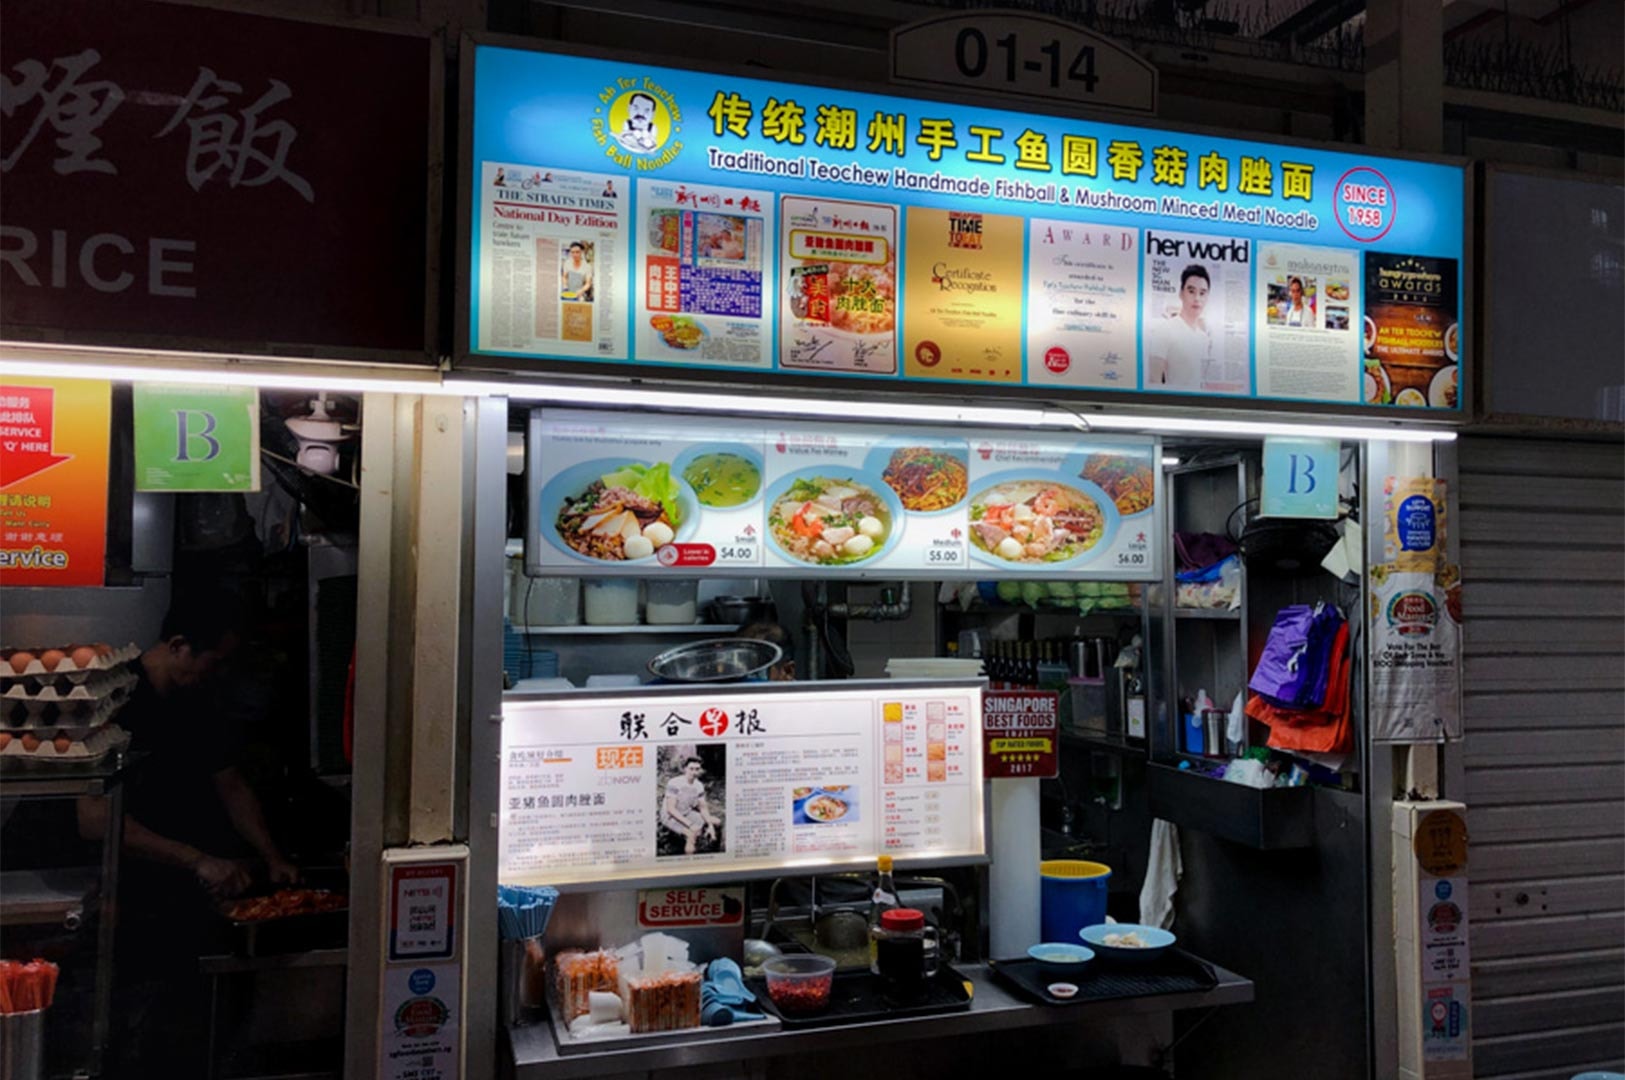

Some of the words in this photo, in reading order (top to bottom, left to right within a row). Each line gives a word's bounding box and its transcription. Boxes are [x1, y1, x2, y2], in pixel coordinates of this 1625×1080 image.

[955, 27, 1099, 93] 01-14
[708, 90, 1315, 200] 传统潮州手工鱼圆香菇肉脞面
[606, 146, 632, 169] Ball
[636, 140, 684, 171] Noodles
[709, 149, 804, 176] Traditional
[810, 160, 889, 185] Teochew
[895, 171, 989, 196] Handmade
[995, 180, 1055, 201] Fishball
[1060, 187, 1070, 202] &
[1076, 190, 1157, 213] Mushroom
[1162, 197, 1218, 218] Minced
[1223, 205, 1262, 222] Meat
[1265, 209, 1317, 229] Noodle
[1343, 185, 1386, 204] SINCE
[497, 189, 524, 201] THE
[526, 192, 576, 206] STRAITS
[578, 197, 615, 210] TIMES
[494, 206, 545, 223] National
[548, 212, 571, 226] Day
[575, 215, 619, 230] Edition
[950, 218, 982, 233] TIME
[1348, 208, 1381, 226] 1958
[1043, 226, 1133, 251] AWARD
[1147, 231, 1184, 257] her
[1187, 239, 1249, 264] world
[0, 225, 197, 298] RICE
[932, 261, 992, 281] Certificate
[842, 277, 878, 295] 十大
[1379, 279, 1441, 294] awards
[169, 409, 221, 463] B
[21, 442, 49, 453] HERE
[1287, 453, 1316, 495] B
[735, 535, 757, 544] Small
[932, 539, 962, 547] Medium
[720, 546, 752, 560] $4.00
[929, 550, 958, 562] $5.00
[1117, 554, 1145, 565] $6.00
[985, 697, 1055, 713] SINGAPORE
[987, 714, 1013, 728] BEST
[1017, 714, 1053, 727] FOODS
[597, 746, 643, 769] 现在
[1010, 763, 1032, 773] 2017
[666, 889, 707, 905] SELF
[650, 904, 721, 918] SERVICE
